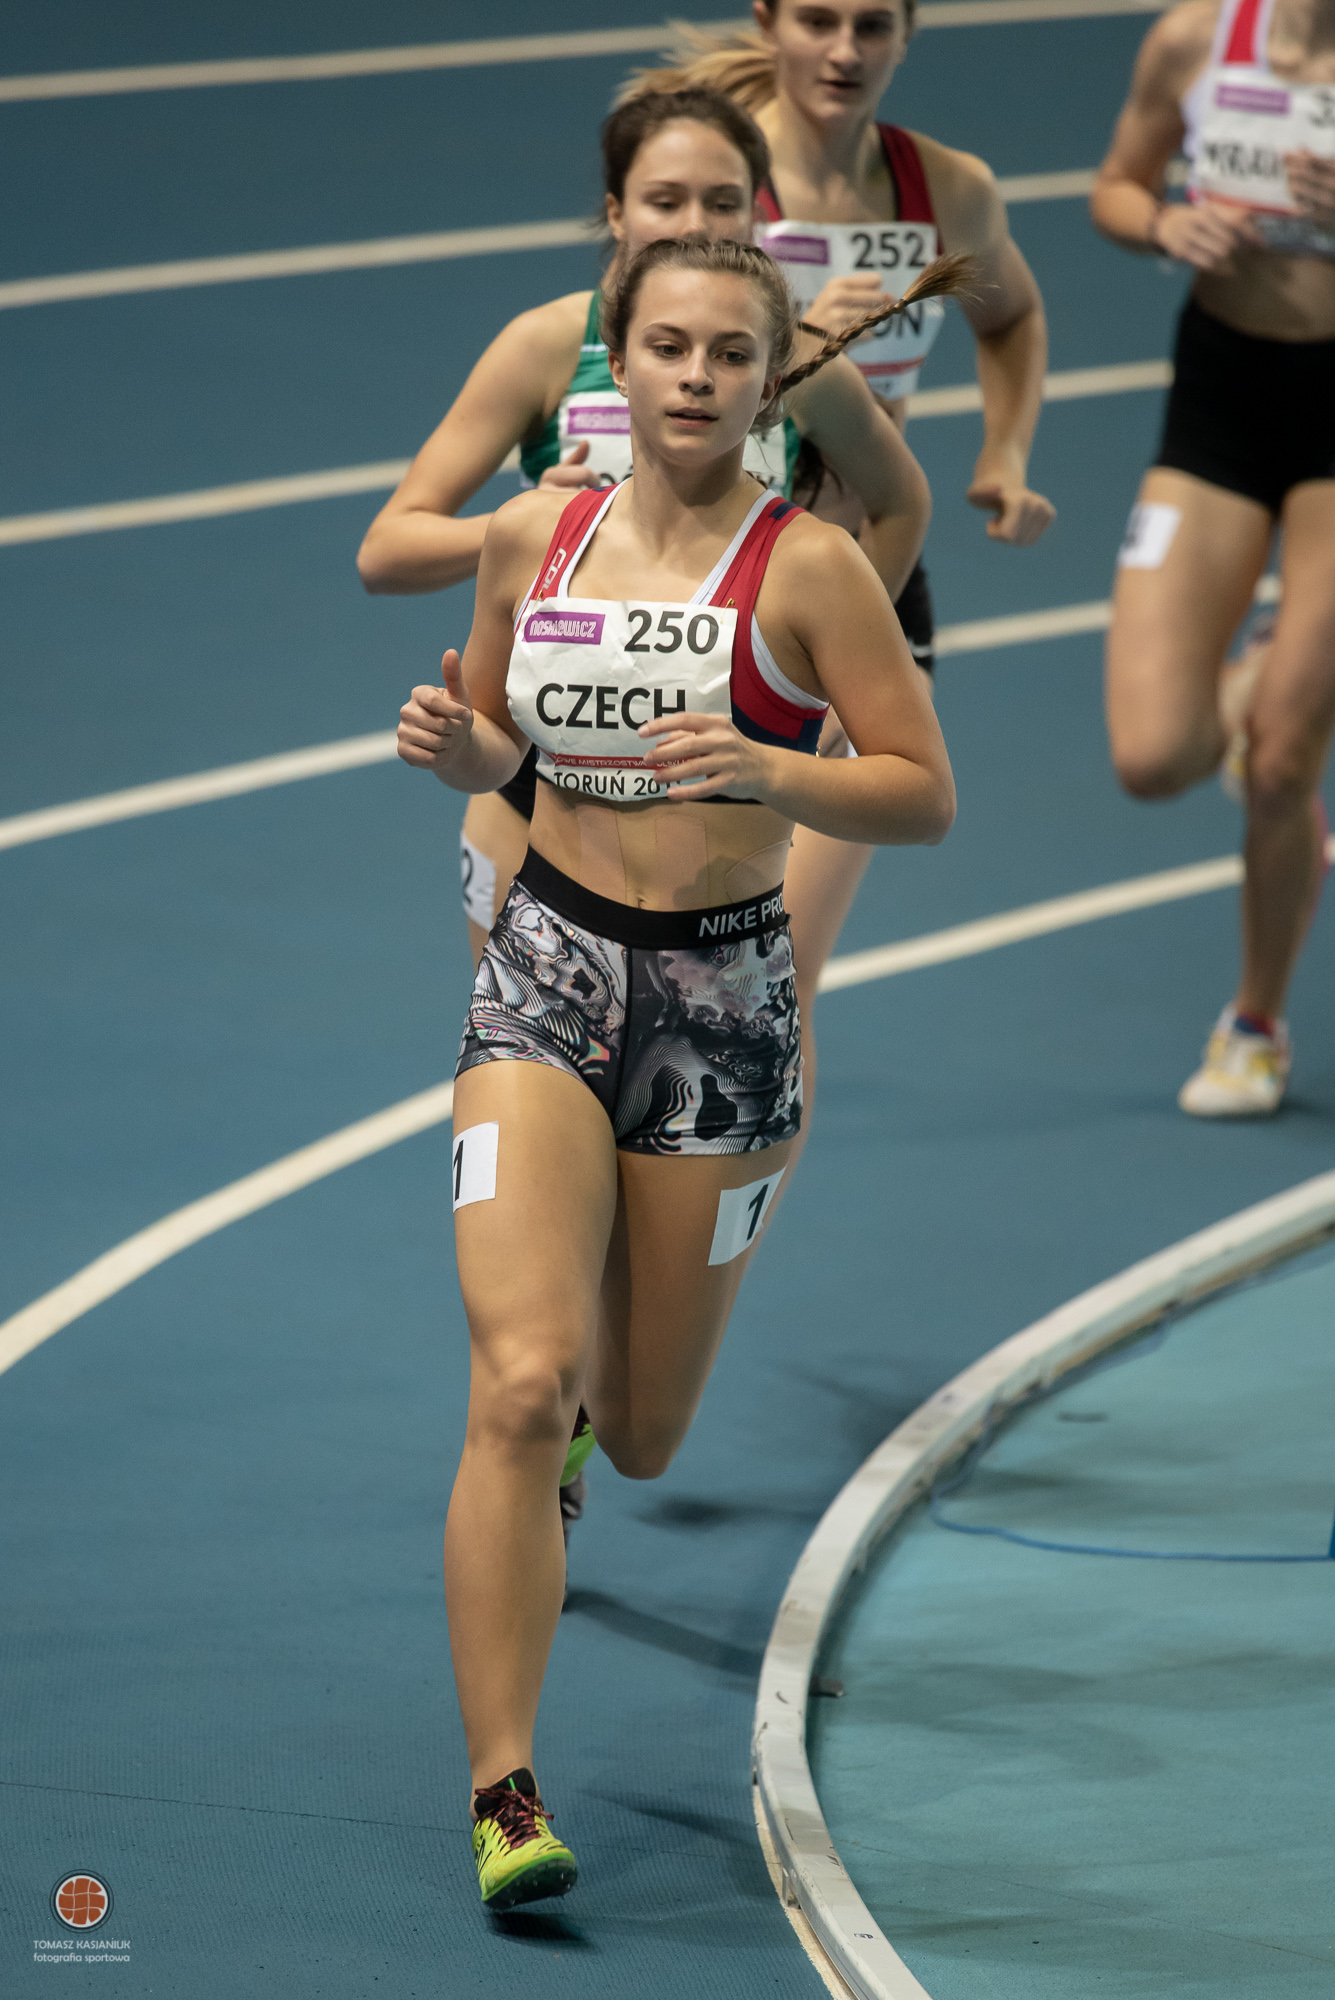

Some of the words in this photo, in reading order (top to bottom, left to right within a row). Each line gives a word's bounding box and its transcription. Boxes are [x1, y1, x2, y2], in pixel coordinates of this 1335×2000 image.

[851, 232, 926, 269] 252
[624, 608, 719, 654] 250
[536, 683, 686, 730] CZECH
[554, 770, 625, 795] TORUŃ
[699, 906, 757, 937] NIKE
[761, 892, 783, 923] PRO
[453, 1140, 464, 1201] 1
[747, 1183, 769, 1241] 1
